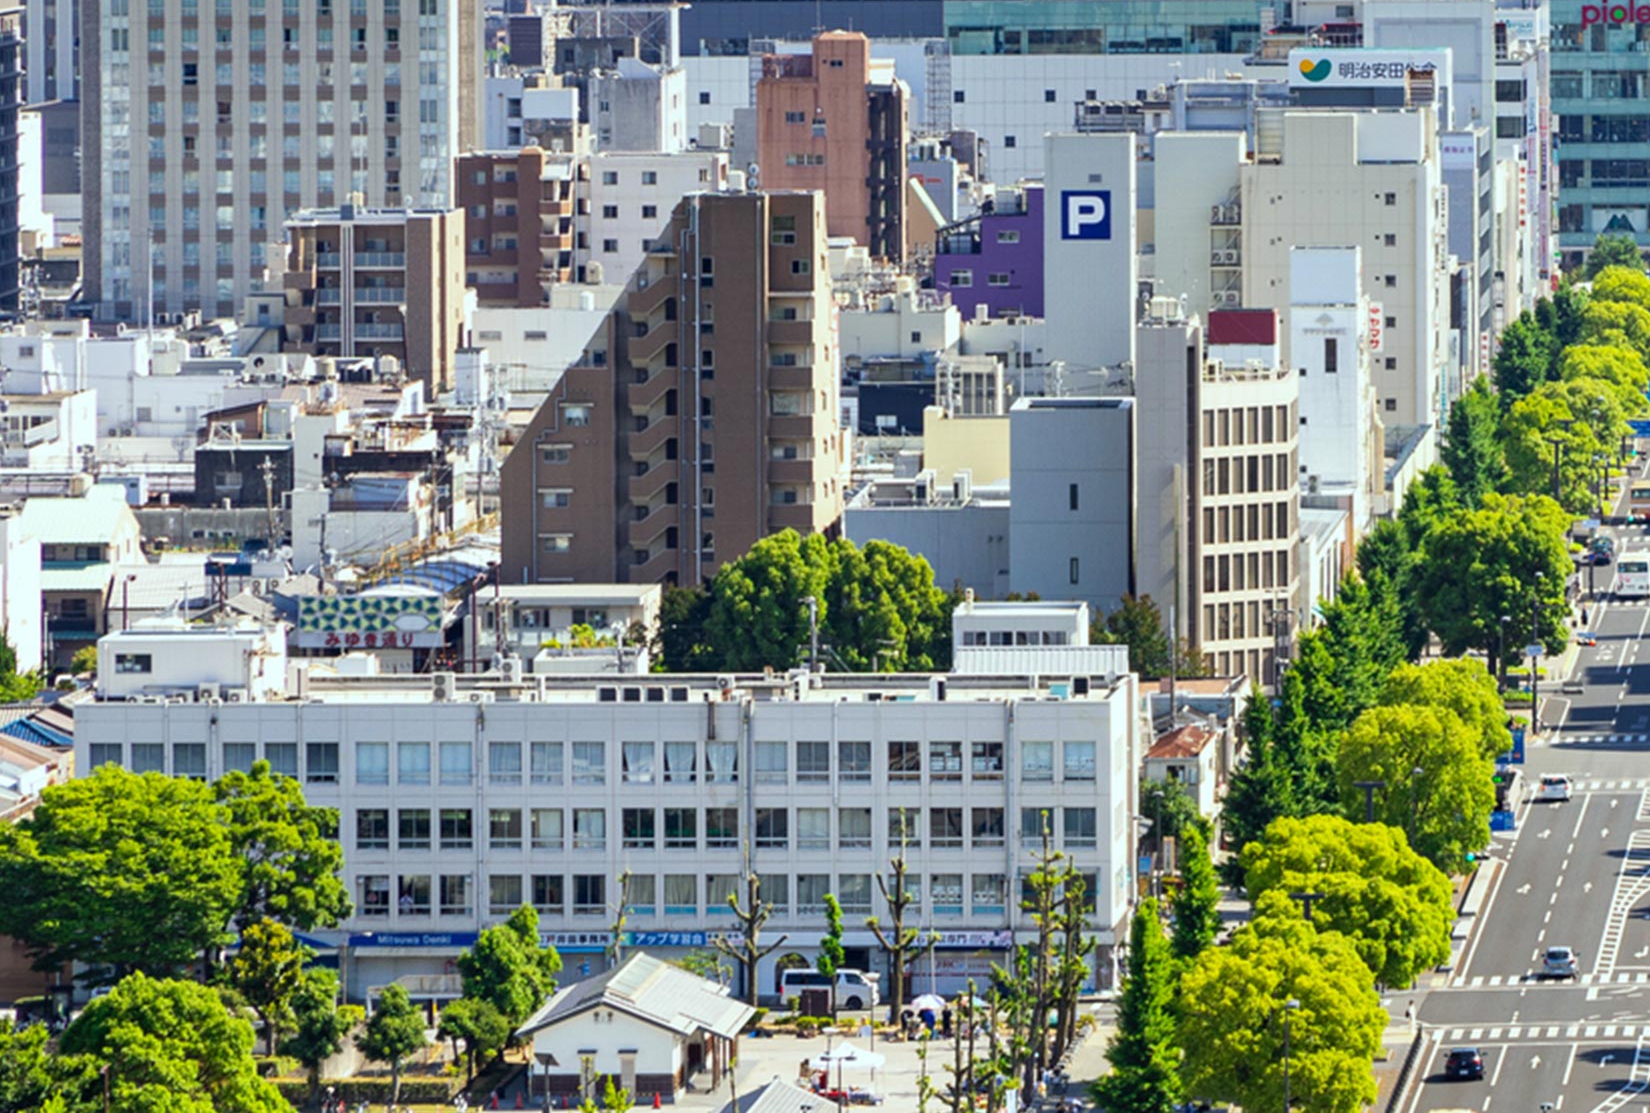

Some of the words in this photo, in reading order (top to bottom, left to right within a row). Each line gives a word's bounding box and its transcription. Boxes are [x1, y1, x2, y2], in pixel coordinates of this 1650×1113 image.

[1068, 195, 1105, 236] P
[325, 632, 414, 647] みゆき通り
[636, 932, 704, 945] アップ学習会
